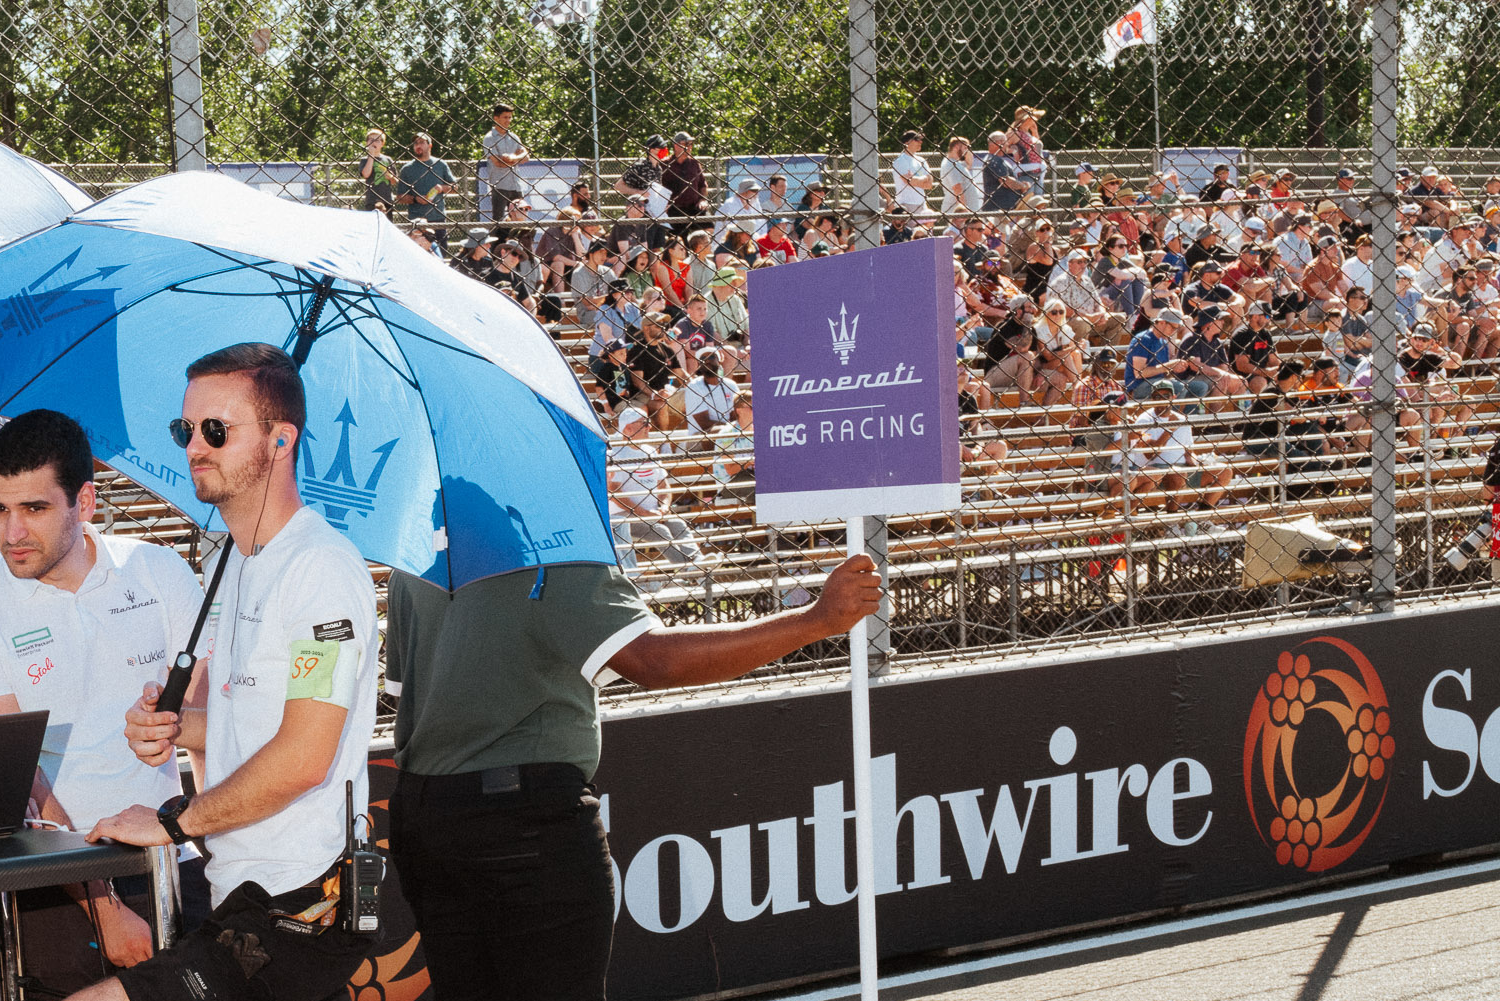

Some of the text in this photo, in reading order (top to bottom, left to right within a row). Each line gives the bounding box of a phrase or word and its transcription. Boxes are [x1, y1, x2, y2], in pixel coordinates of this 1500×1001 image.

[768, 362, 923, 397] Maserati
[769, 413, 924, 448] MSG RACING
[27, 656, 54, 685] Stoli
[600, 726, 1214, 934] outhwire
